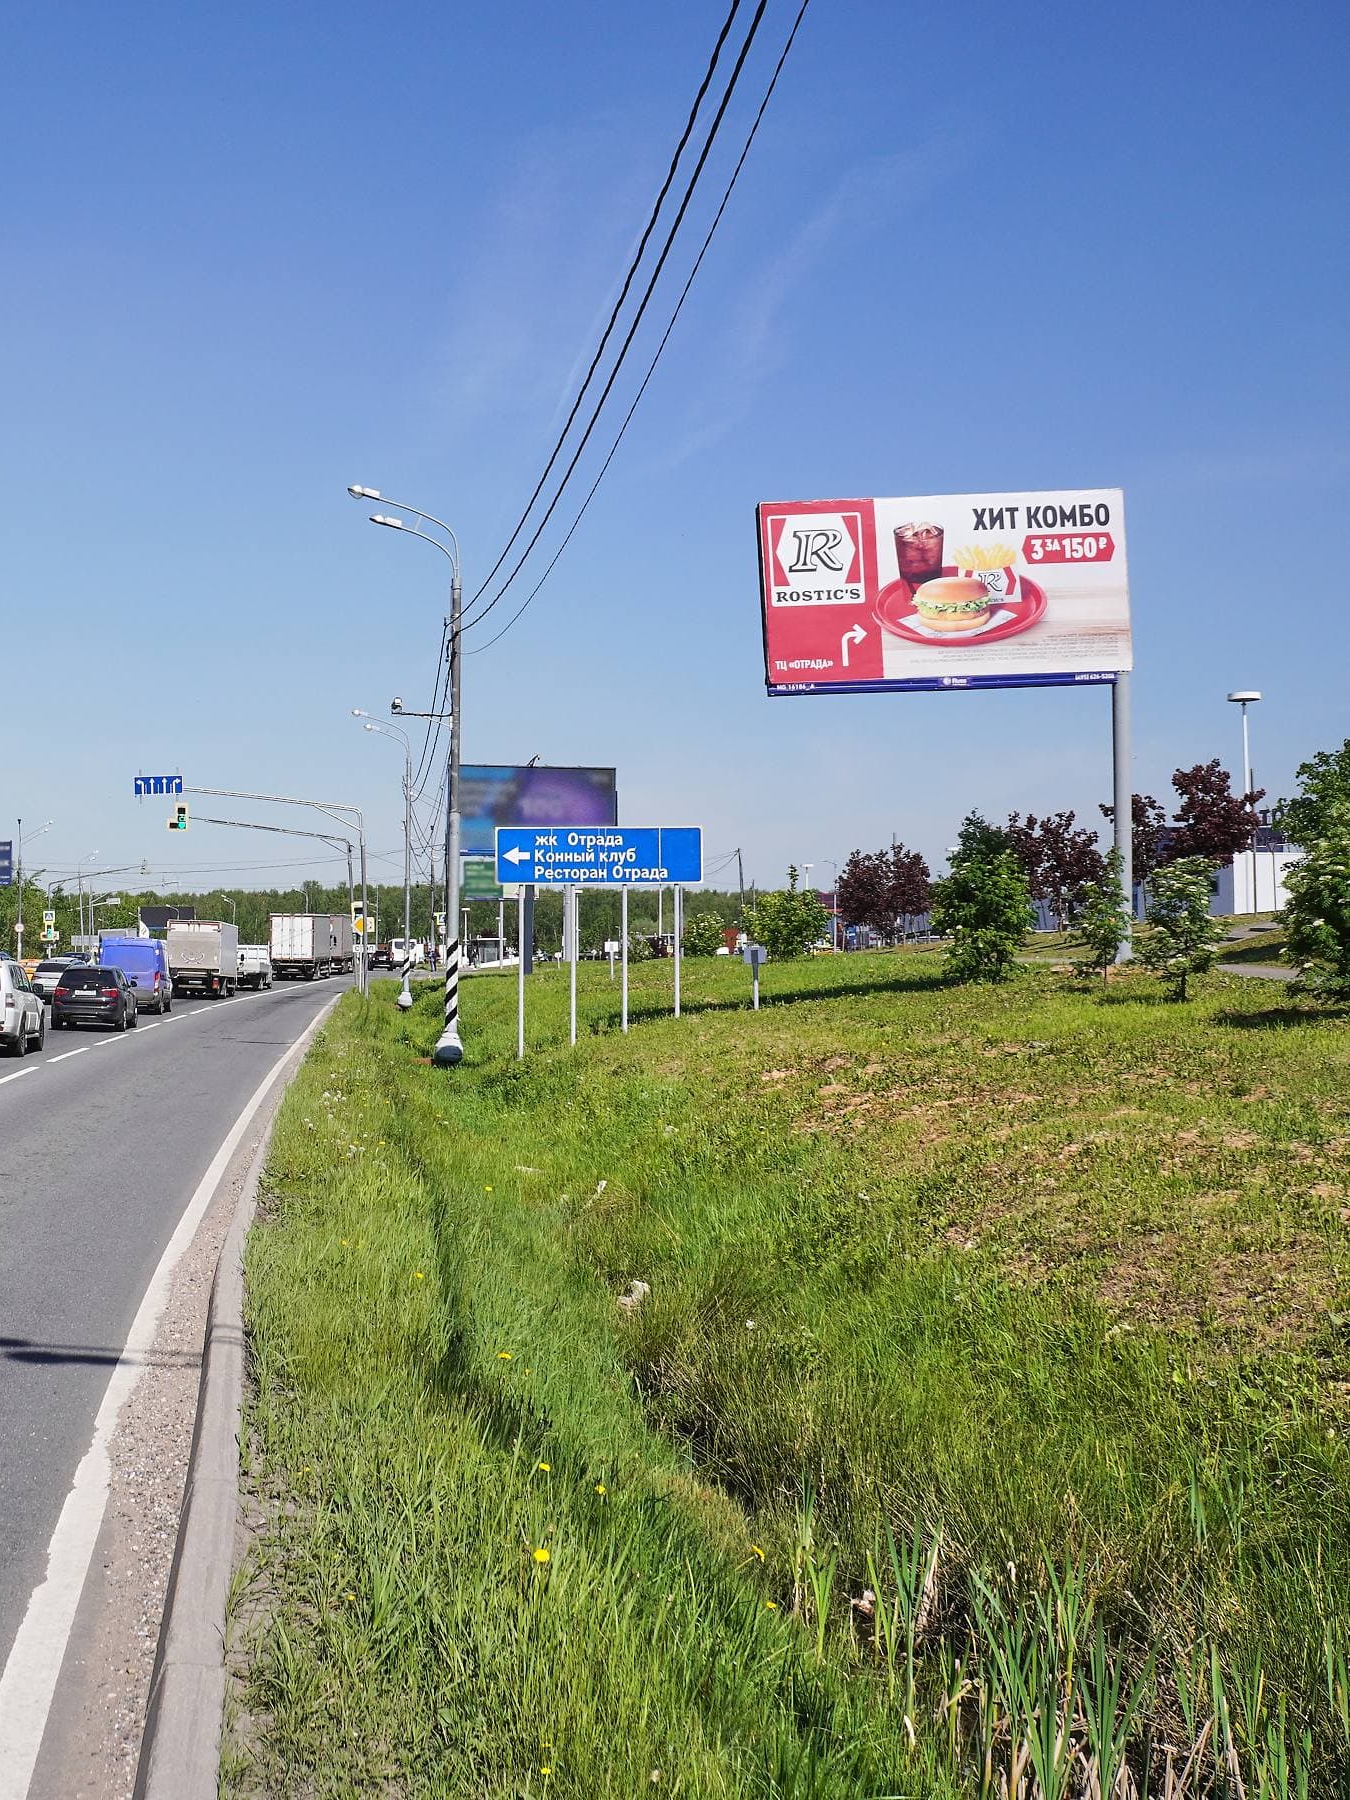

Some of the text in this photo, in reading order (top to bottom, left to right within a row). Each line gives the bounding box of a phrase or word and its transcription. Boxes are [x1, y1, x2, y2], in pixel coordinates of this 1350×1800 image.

[972, 503, 1110, 531] ХИТ КОМБО
[776, 588, 861, 603] ROSTIC'S
[775, 659, 834, 671] ТЦ «ОТРАДА»
[535, 832, 624, 847] жк Отрада
[534, 846, 637, 865] Конный клуб
[534, 865, 668, 881] Ресторан Отрада
